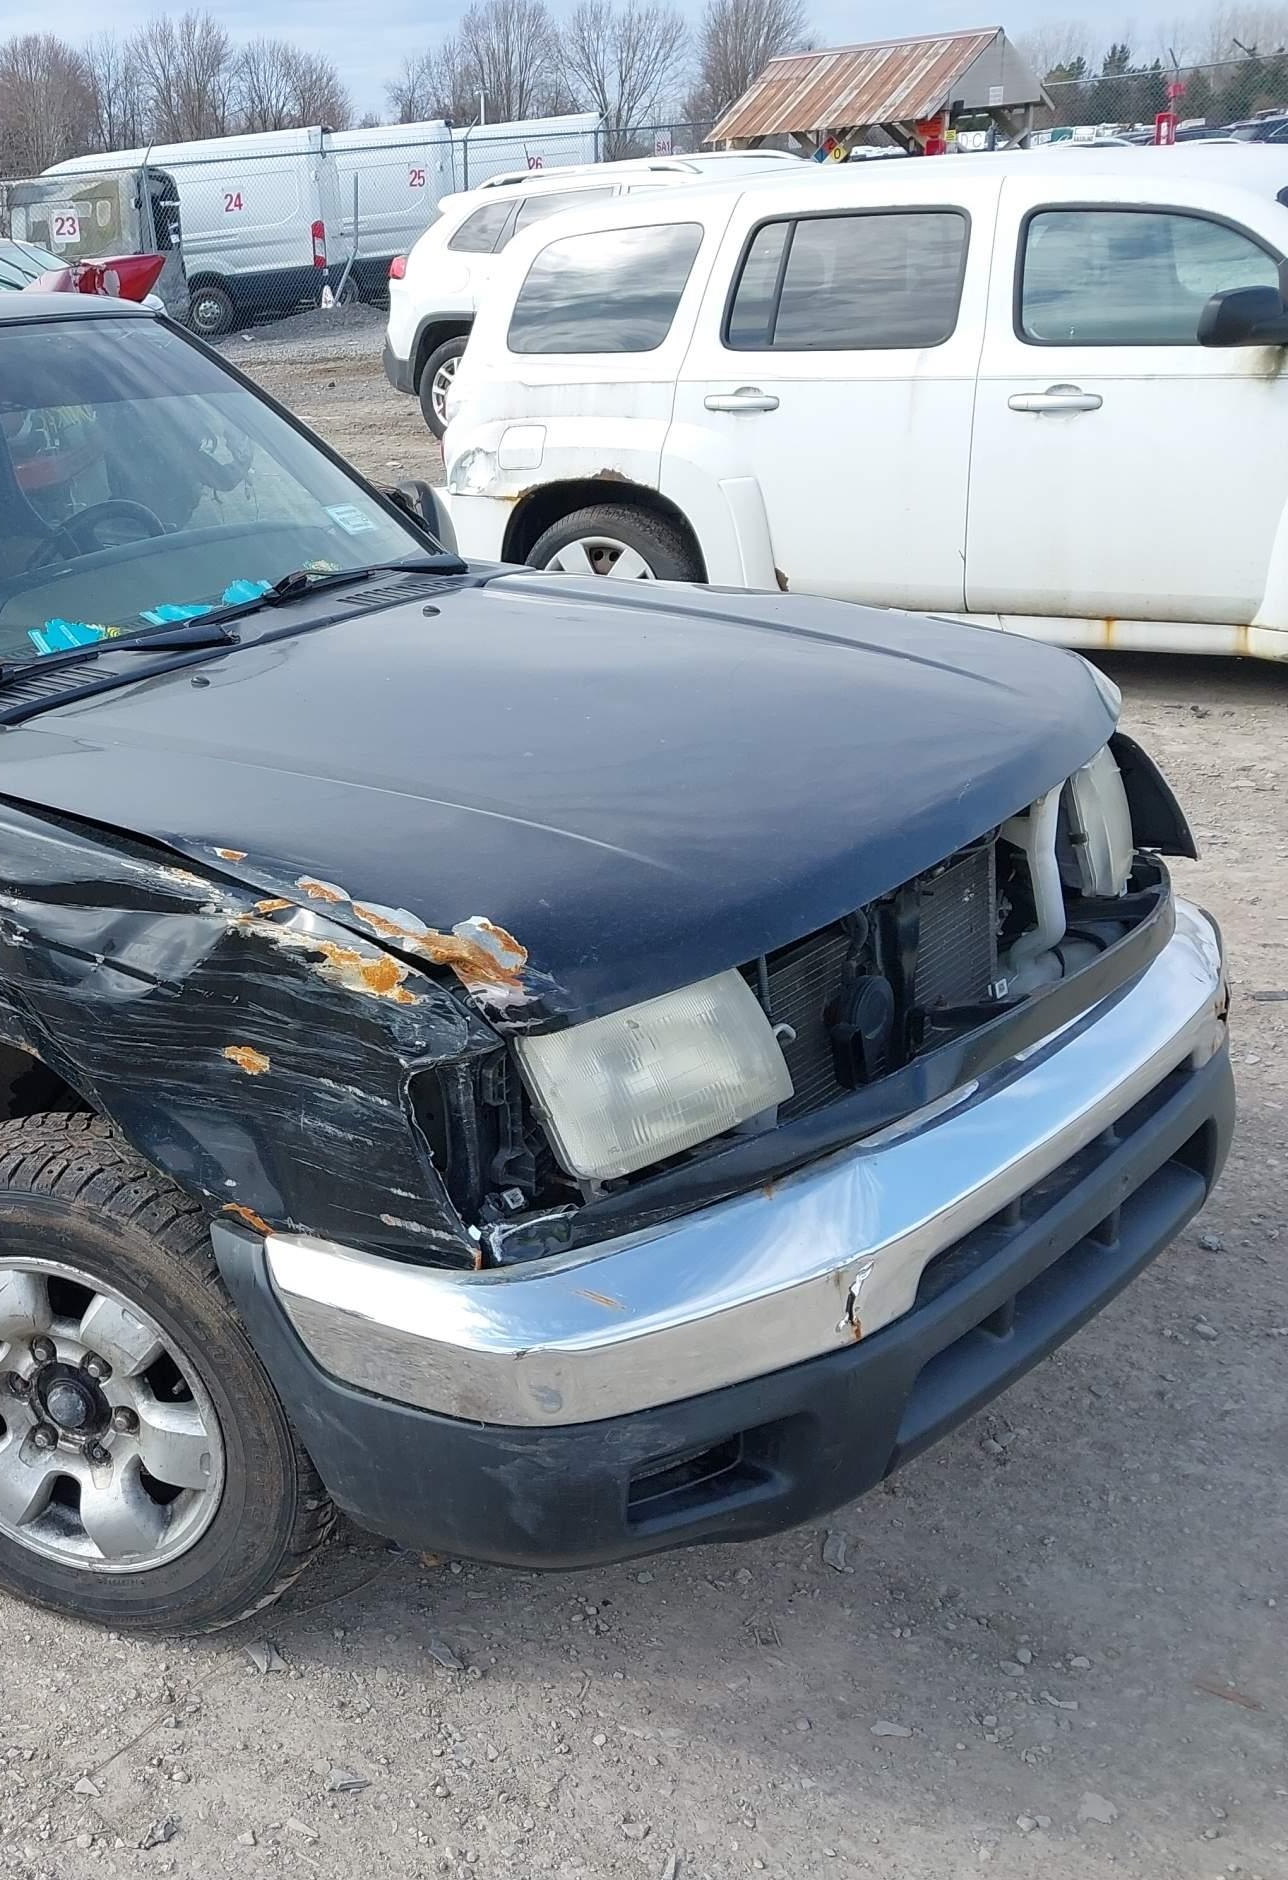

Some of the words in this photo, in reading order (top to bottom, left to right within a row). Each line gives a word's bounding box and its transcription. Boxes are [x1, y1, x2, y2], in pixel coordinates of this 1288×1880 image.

[656, 140, 670, 152] SA1
[409, 169, 425, 187] 25
[224, 192, 243, 212] 24
[55, 217, 77, 236] 23
